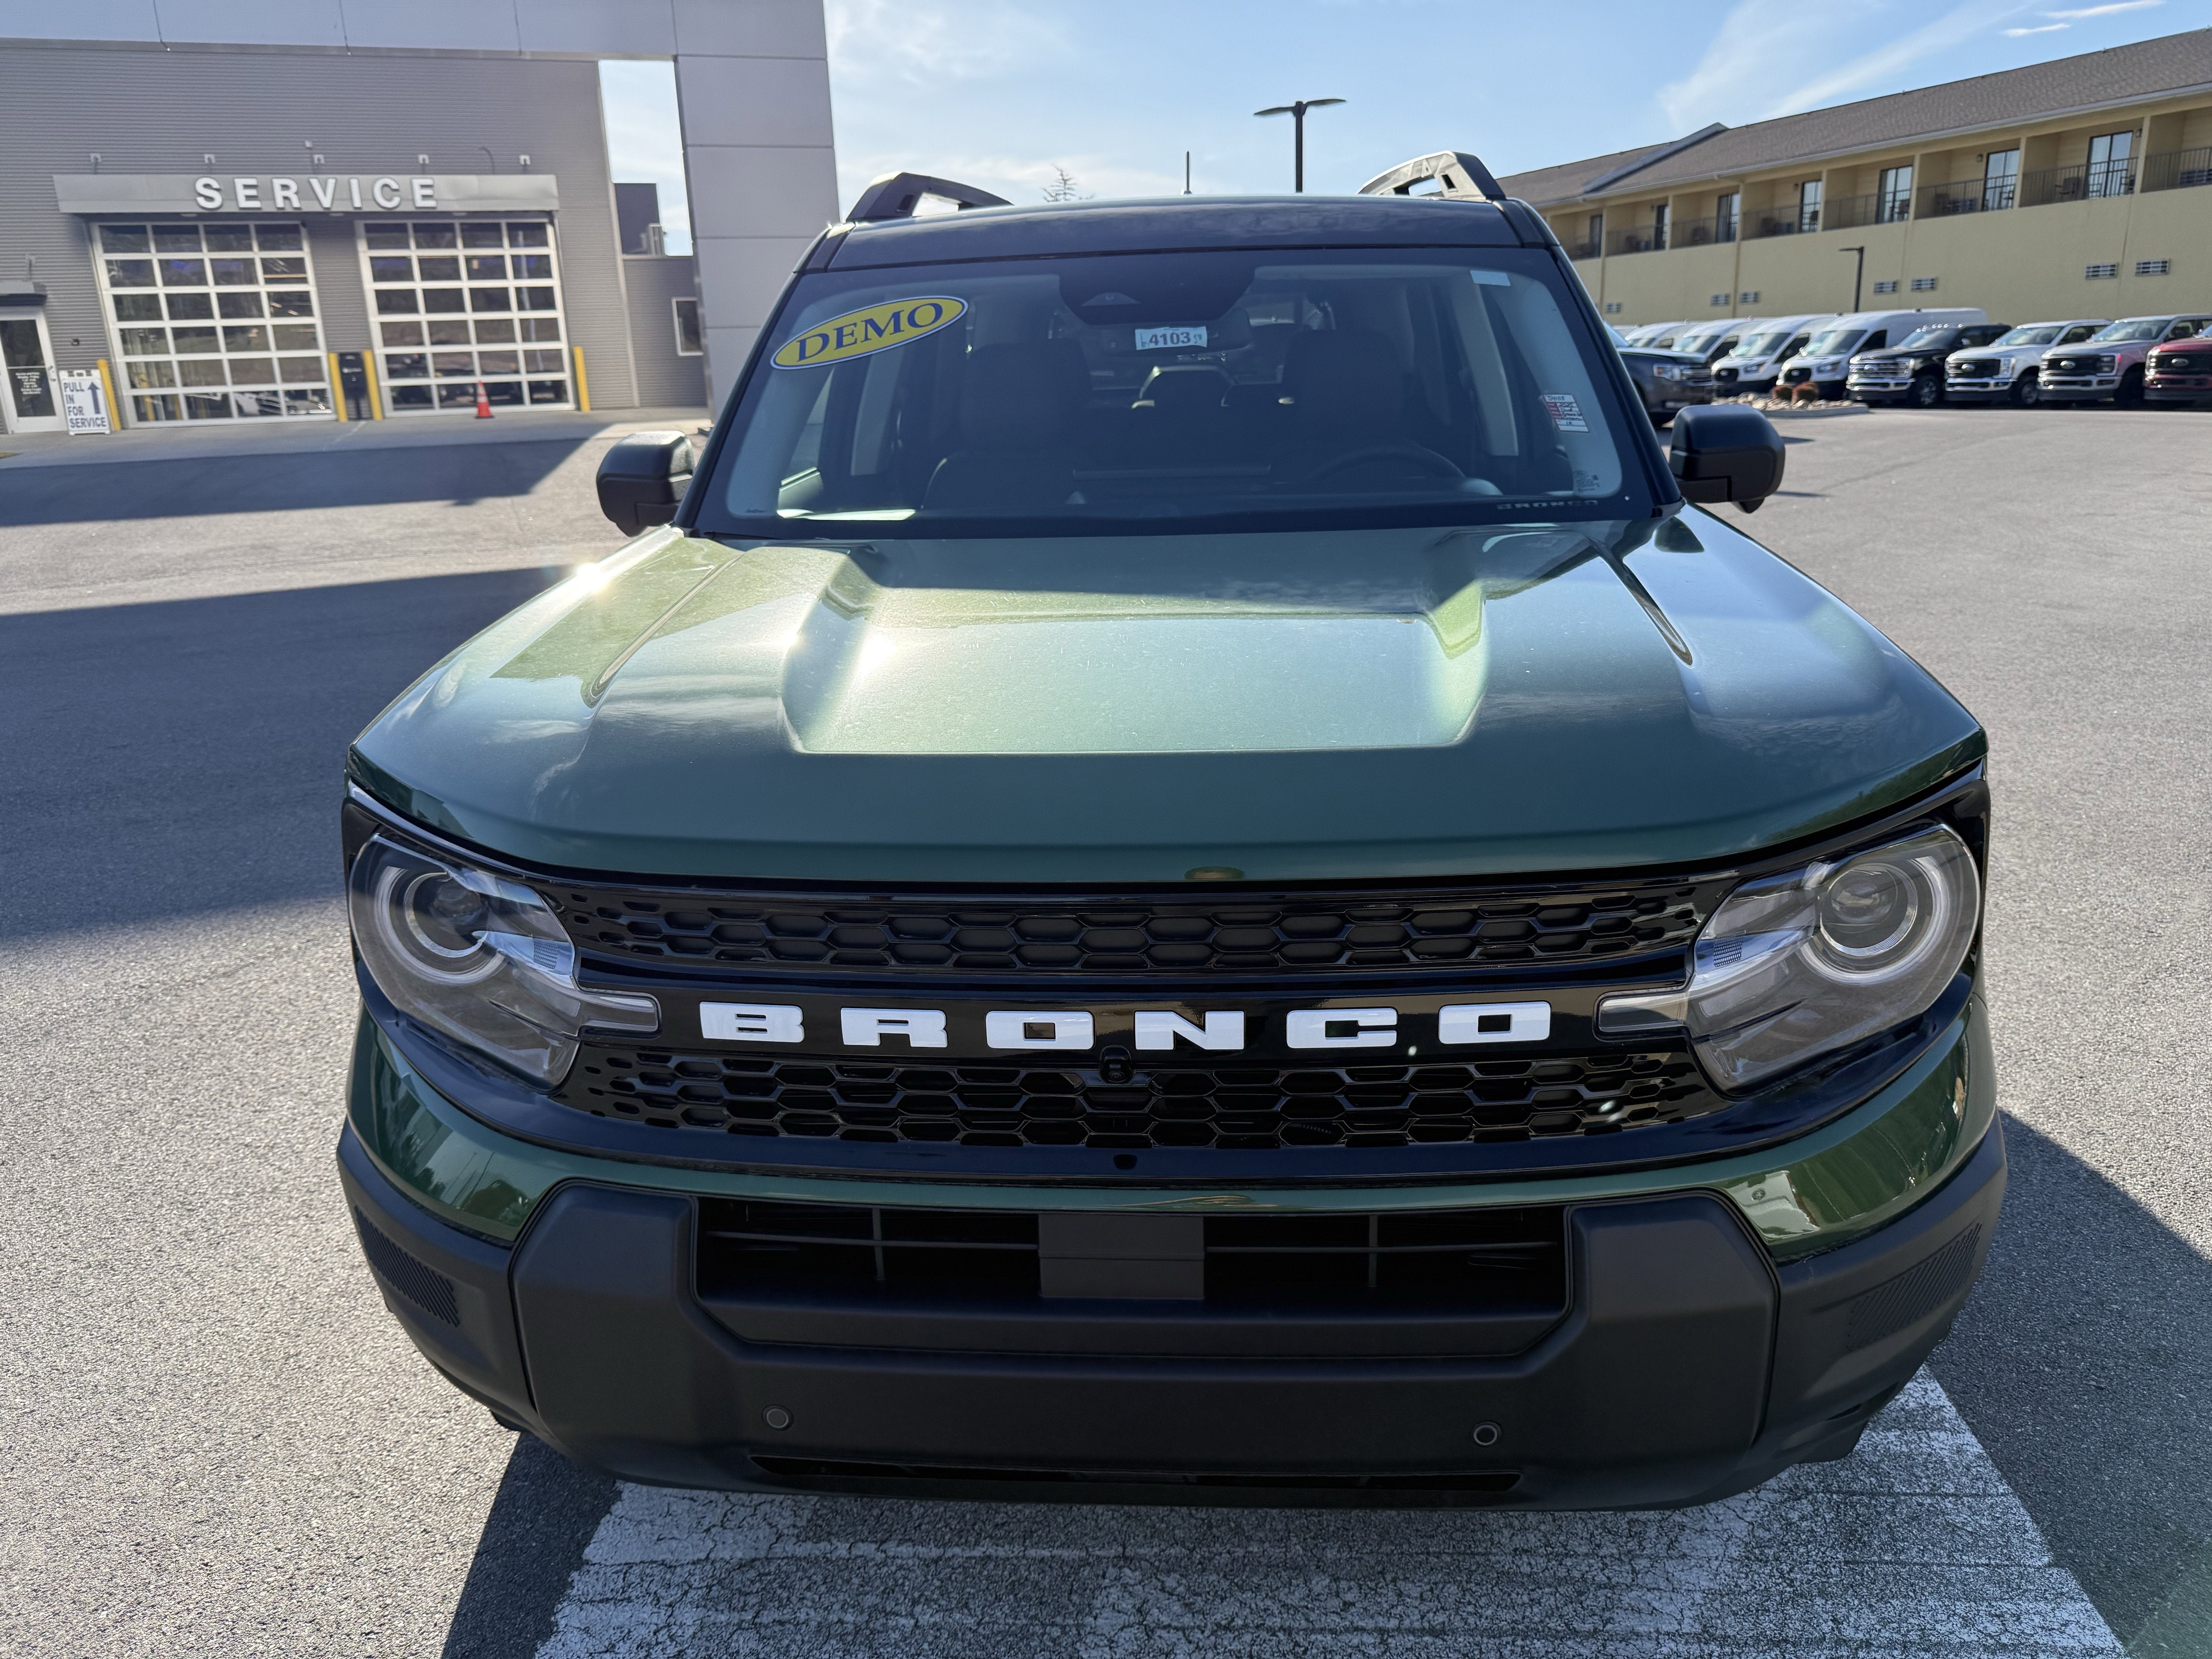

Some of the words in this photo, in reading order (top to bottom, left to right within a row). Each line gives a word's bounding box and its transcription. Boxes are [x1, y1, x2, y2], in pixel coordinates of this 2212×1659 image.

[195, 177, 438, 210] SERVICE
[796, 302, 943, 362] DEMO
[1149, 332, 1191, 346] 4103
[64, 381, 84, 392] PULL
[65, 394, 75, 404] IN
[67, 406, 84, 416] FOR
[69, 417, 106, 428] SERVICE
[699, 1001, 1551, 1050] BRONCO
